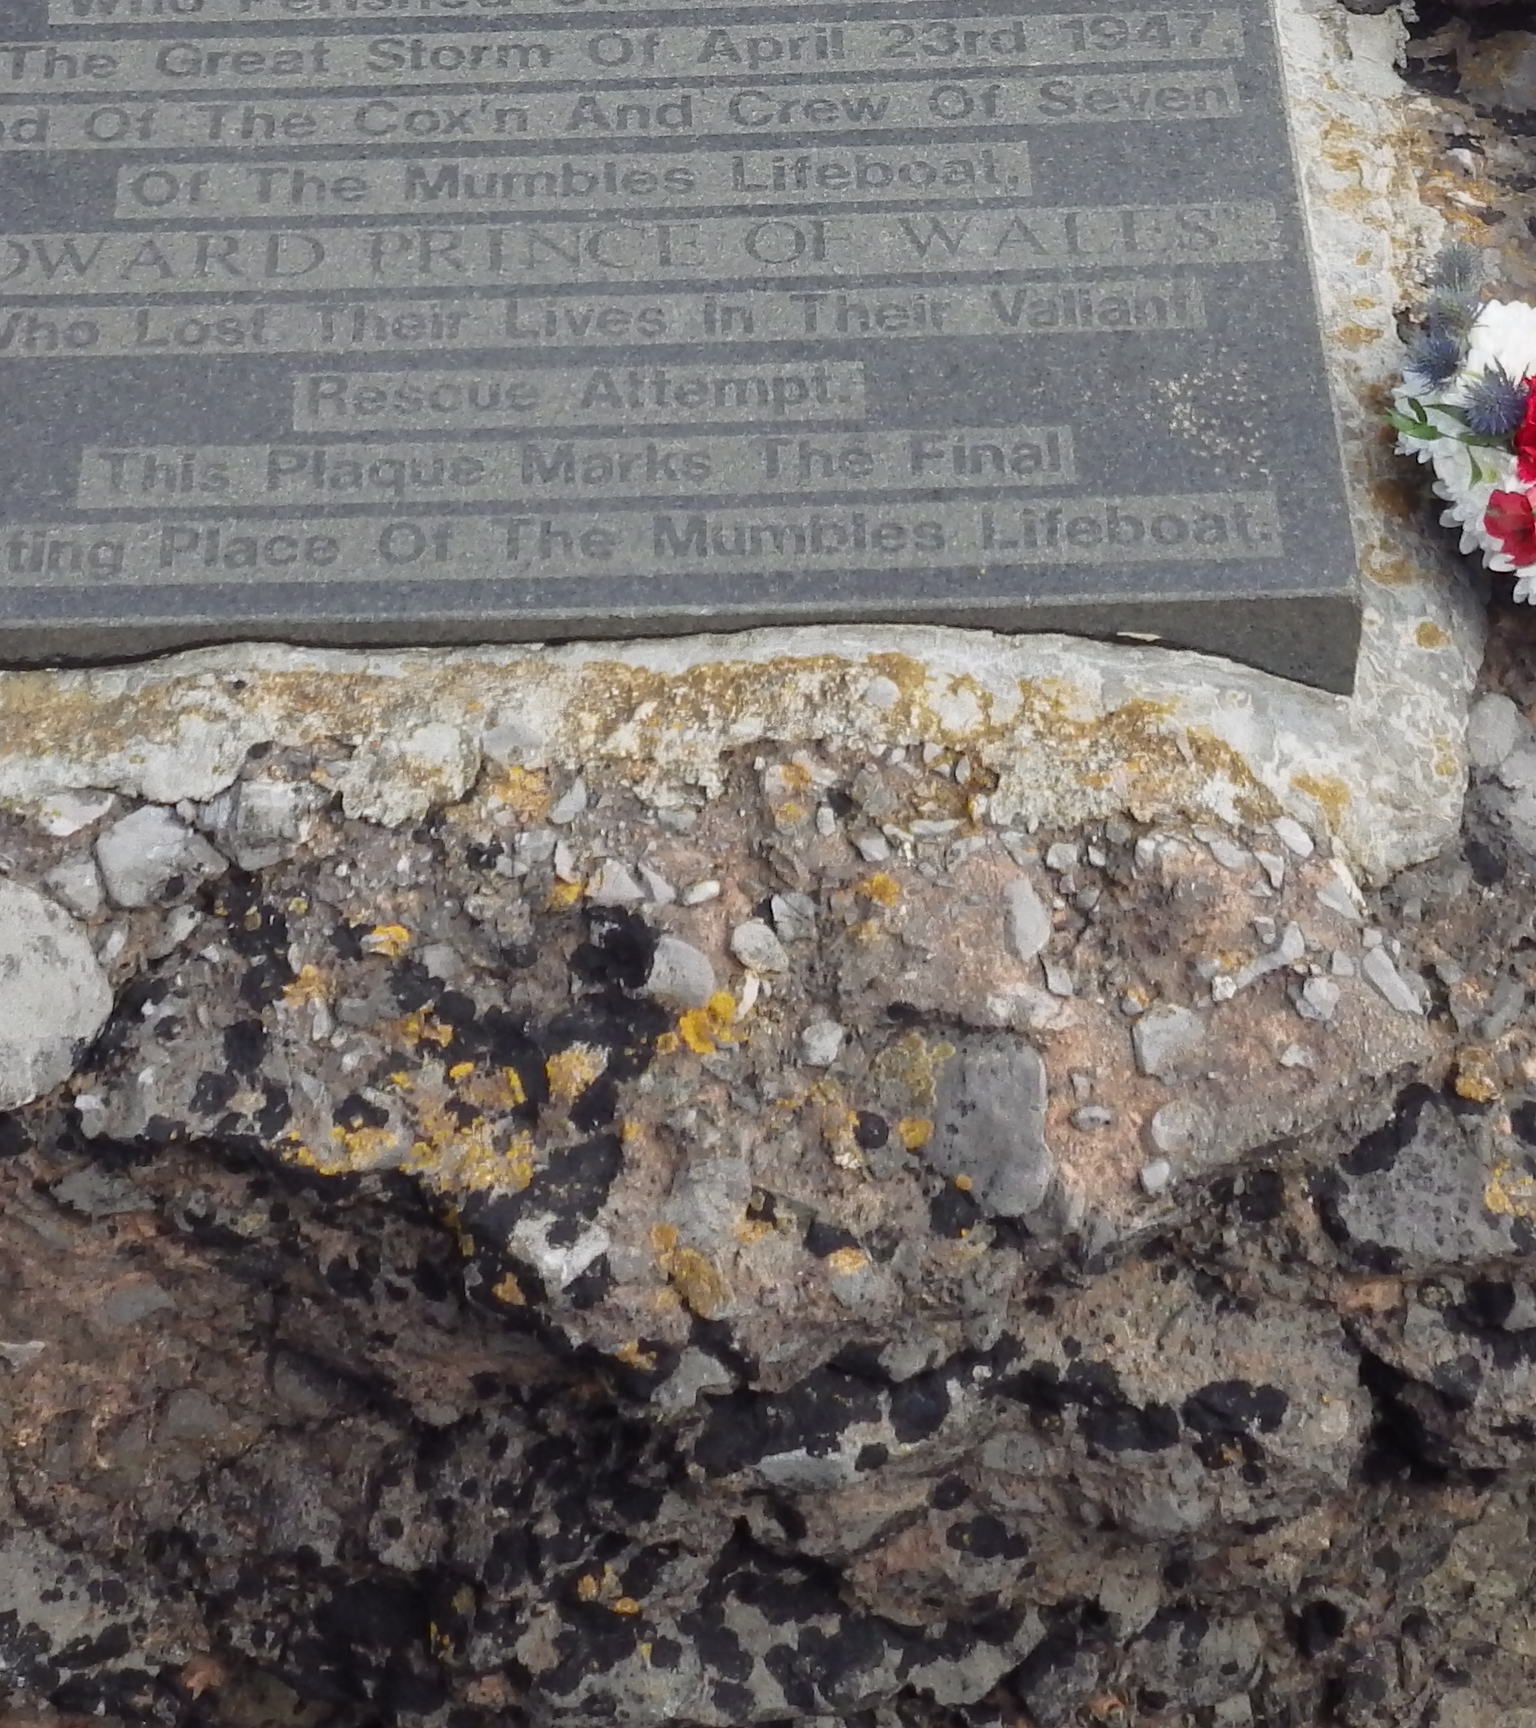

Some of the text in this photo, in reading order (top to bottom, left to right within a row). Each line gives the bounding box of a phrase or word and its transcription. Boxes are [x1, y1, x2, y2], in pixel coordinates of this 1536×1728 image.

[1, 45, 117, 78] The
[156, 40, 330, 77] Great
[367, 37, 551, 72] Storm
[587, 31, 660, 67] Of
[697, 25, 843, 71] April
[880, 20, 1027, 60] 23rd
[84, 107, 157, 143] Of
[197, 104, 317, 140] The
[354, 99, 528, 136] Cox'n
[568, 94, 693, 130] And
[727, 88, 889, 127] Crew
[928, 84, 1002, 120] Of
[1038, 79, 1228, 118] Seven
[131, 170, 208, 207] Of
[248, 168, 365, 204] The
[404, 161, 695, 202] Mumbles
[367, 222, 704, 274] PRINCE
[743, 218, 852, 264] OF
[135, 308, 265, 349] Lost
[314, 303, 461, 342] Their
[505, 297, 665, 339] Lives
[703, 295, 754, 335] In
[789, 292, 948, 334] Their
[989, 283, 1186, 330] Valiant
[307, 368, 851, 415] Rescue Attempt.
[101, 429, 1061, 496] This Plaque Marks The Final
[161, 524, 340, 571] Place
[377, 520, 454, 565] Of
[503, 517, 614, 562] The
[654, 510, 945, 559] Mumbles
